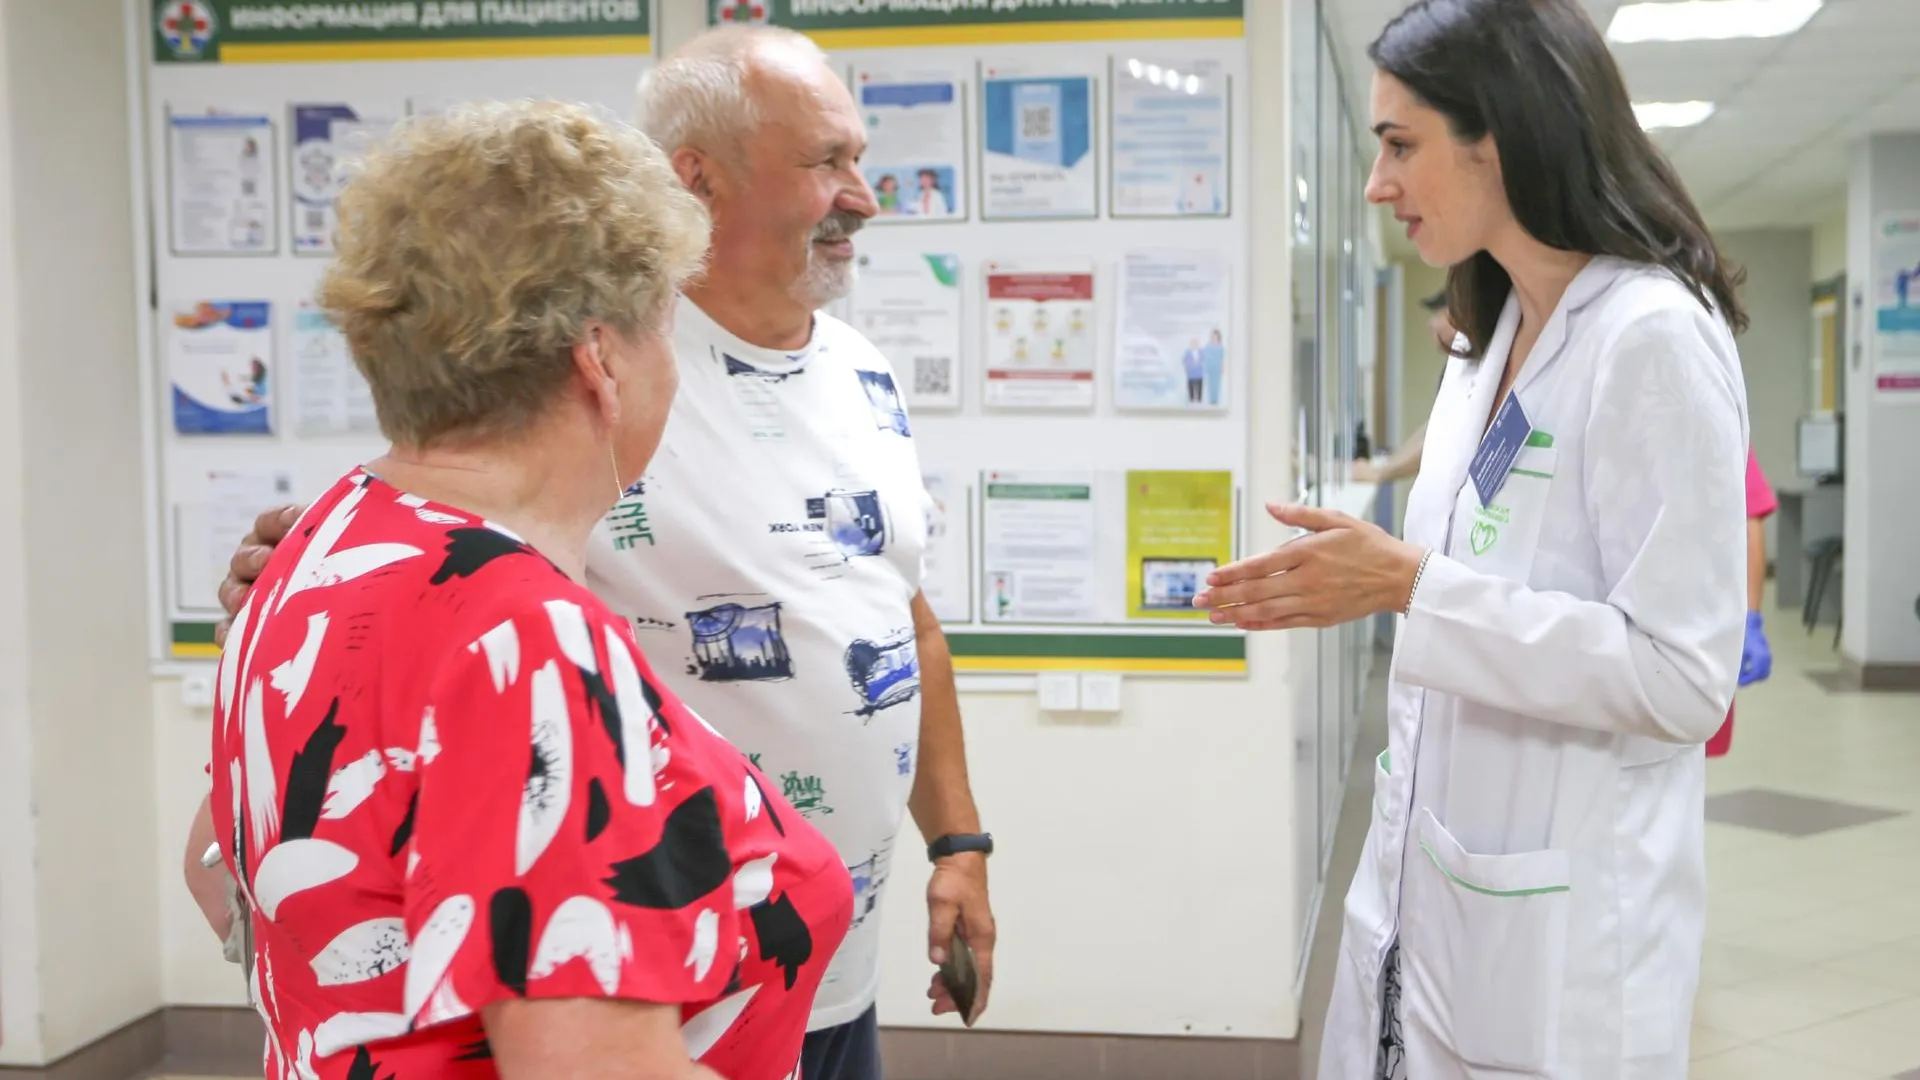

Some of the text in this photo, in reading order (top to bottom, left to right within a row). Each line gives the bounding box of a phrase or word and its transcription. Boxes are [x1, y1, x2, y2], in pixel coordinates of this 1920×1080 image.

[230, 0, 642, 31] ИНФОРМАЦИЯ ДЛЯ ПАЦИЕНТОВ
